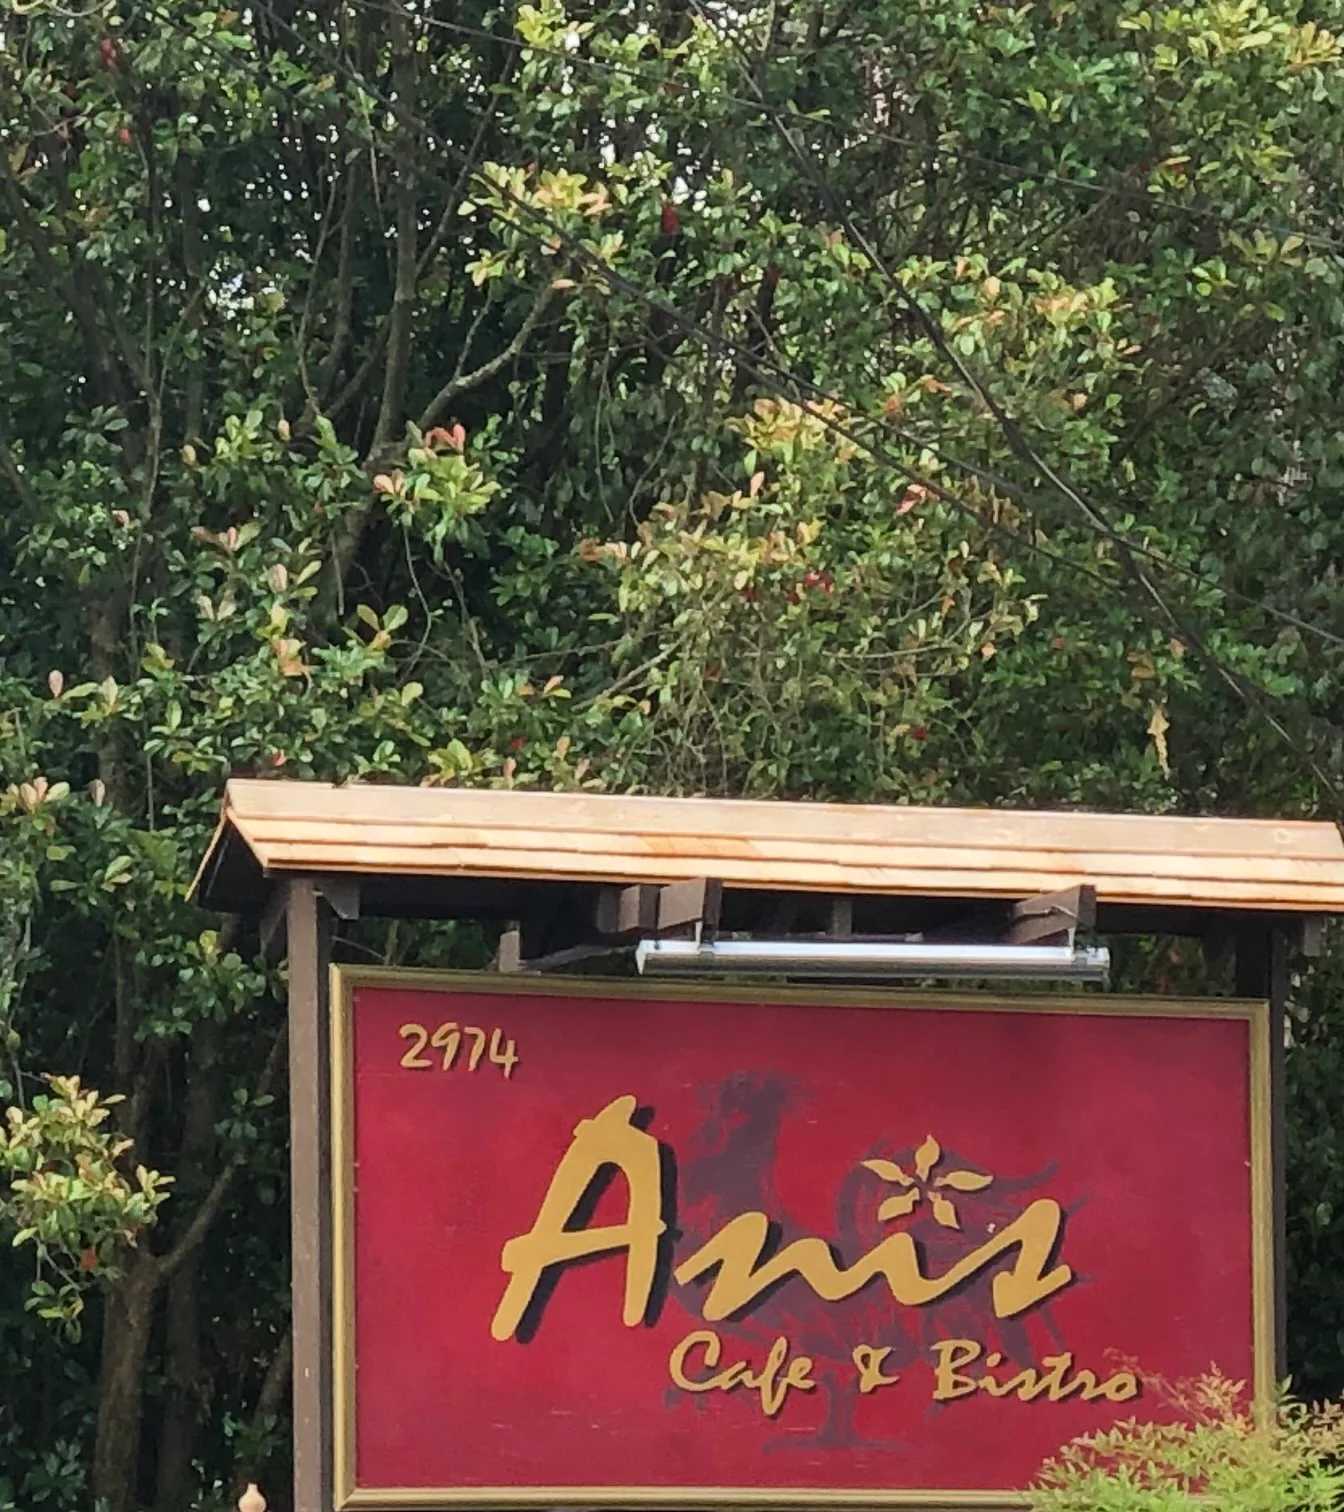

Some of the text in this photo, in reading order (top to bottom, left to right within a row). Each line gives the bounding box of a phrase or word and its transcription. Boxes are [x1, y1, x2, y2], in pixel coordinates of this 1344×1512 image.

[400, 1023, 519, 1078] 2974
[490, 1094, 1072, 1342] Anis
[669, 1331, 1138, 1416] Cafe & Bistro
